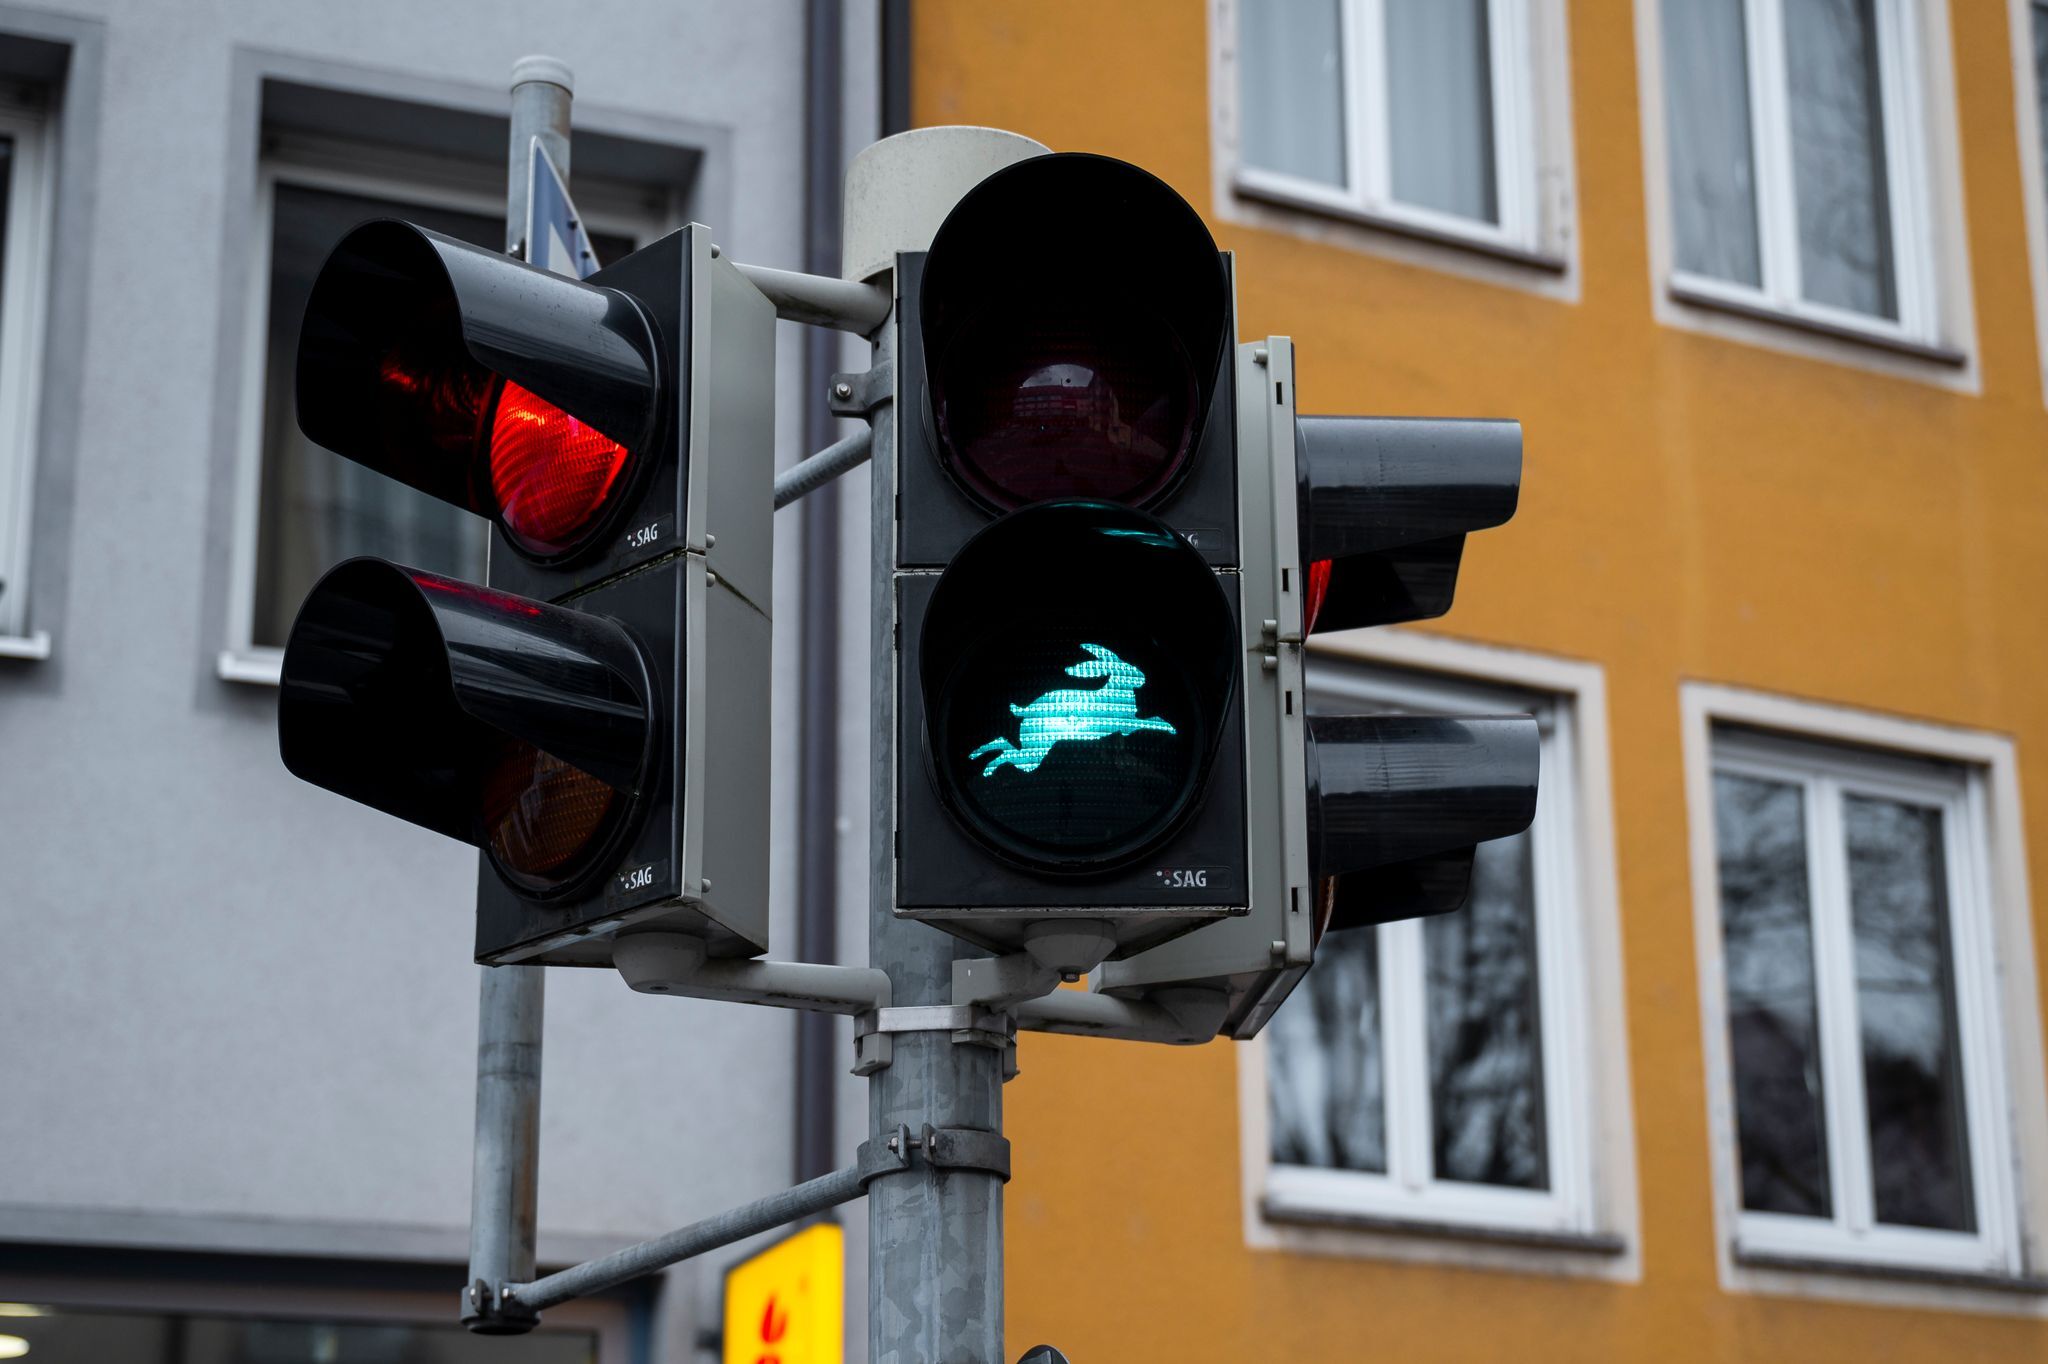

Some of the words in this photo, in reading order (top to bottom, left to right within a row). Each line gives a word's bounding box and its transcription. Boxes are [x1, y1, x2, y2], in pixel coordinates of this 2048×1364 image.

[636, 523, 658, 547] SAG
[630, 866, 652, 889] SAG
[1172, 869, 1207, 888] SAG
